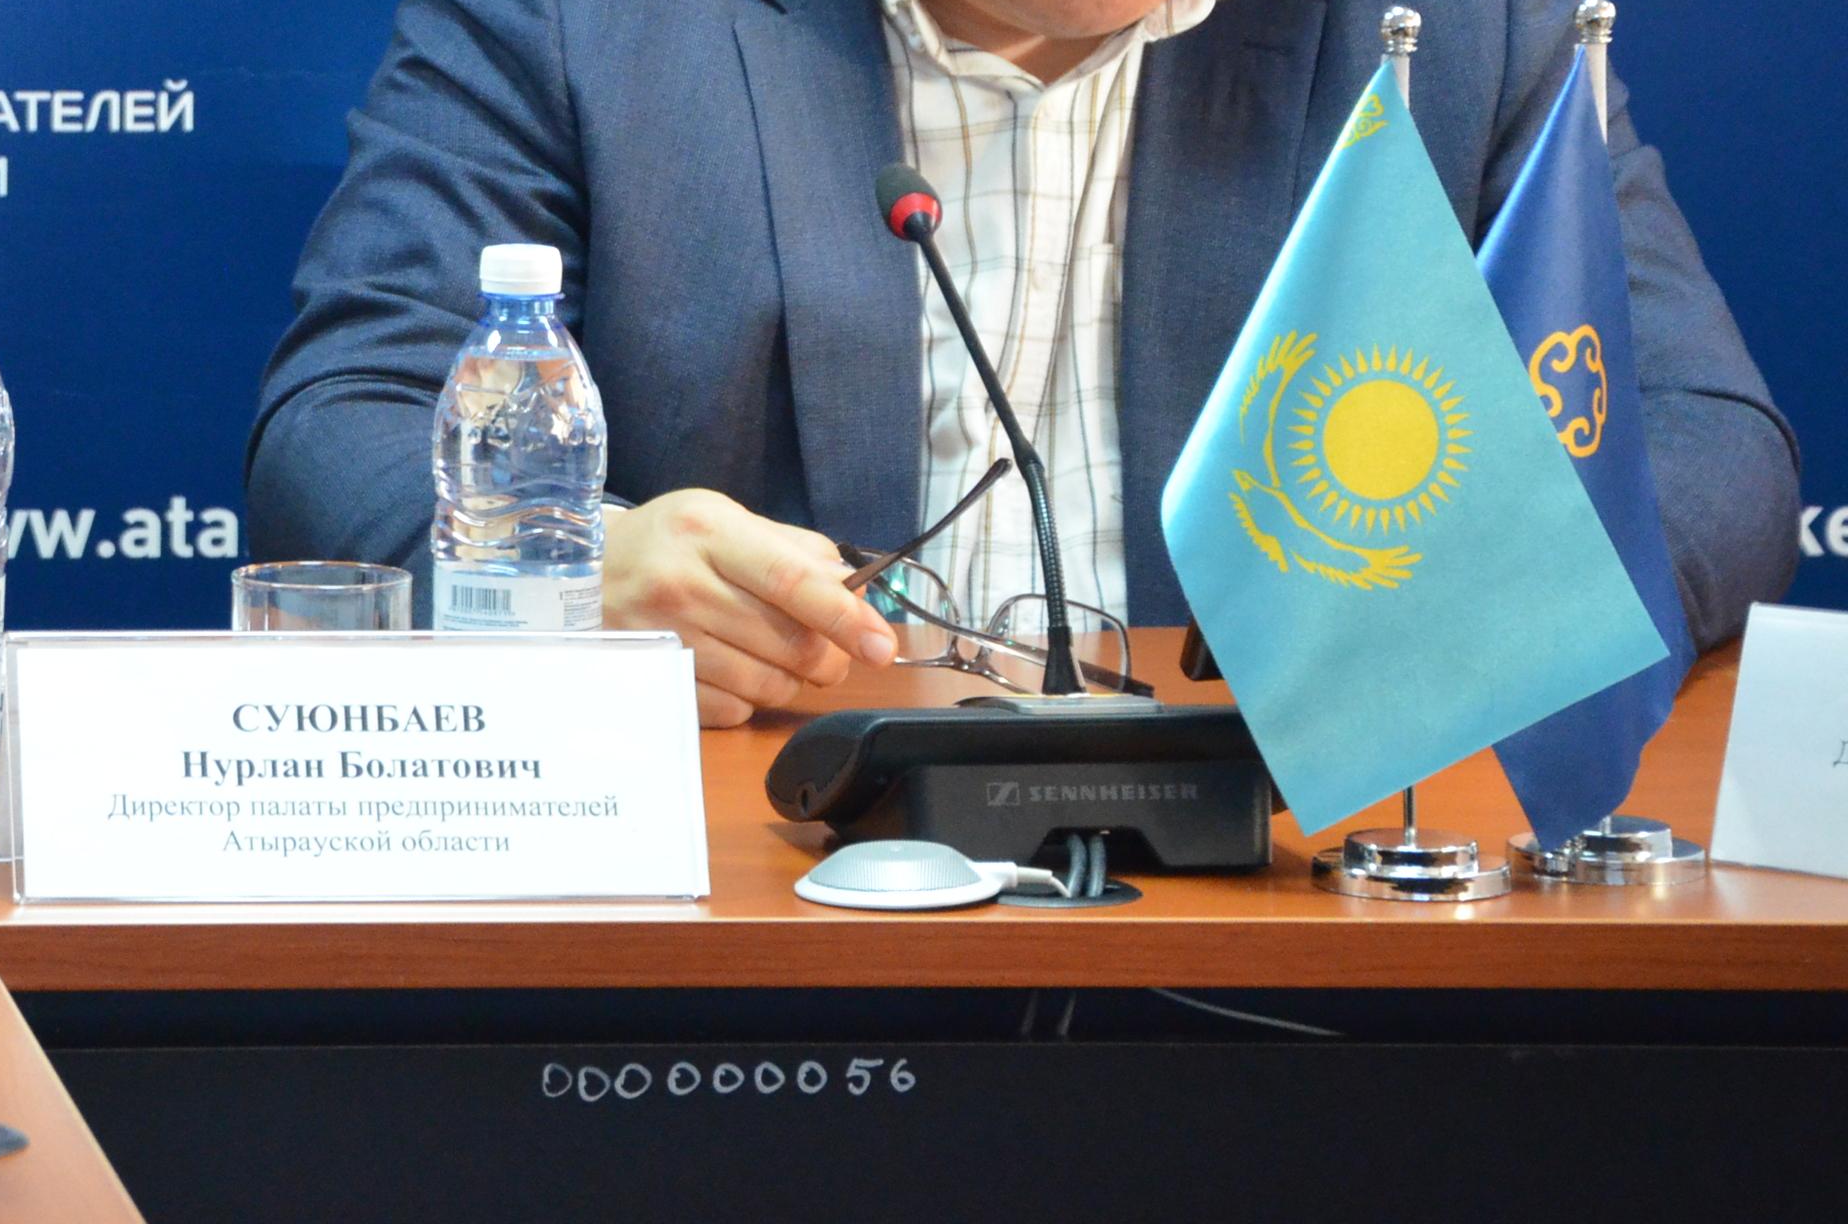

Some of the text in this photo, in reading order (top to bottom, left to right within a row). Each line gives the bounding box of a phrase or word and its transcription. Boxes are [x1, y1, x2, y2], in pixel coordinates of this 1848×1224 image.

[231, 703, 487, 734] СУЮНБАЕВ
[182, 749, 543, 788] Нурлан Болатович
[106, 792, 620, 822] Директор палаты предпринимателей
[1028, 782, 1200, 803] SENNHEISER
[222, 828, 511, 857] Атырауской области
